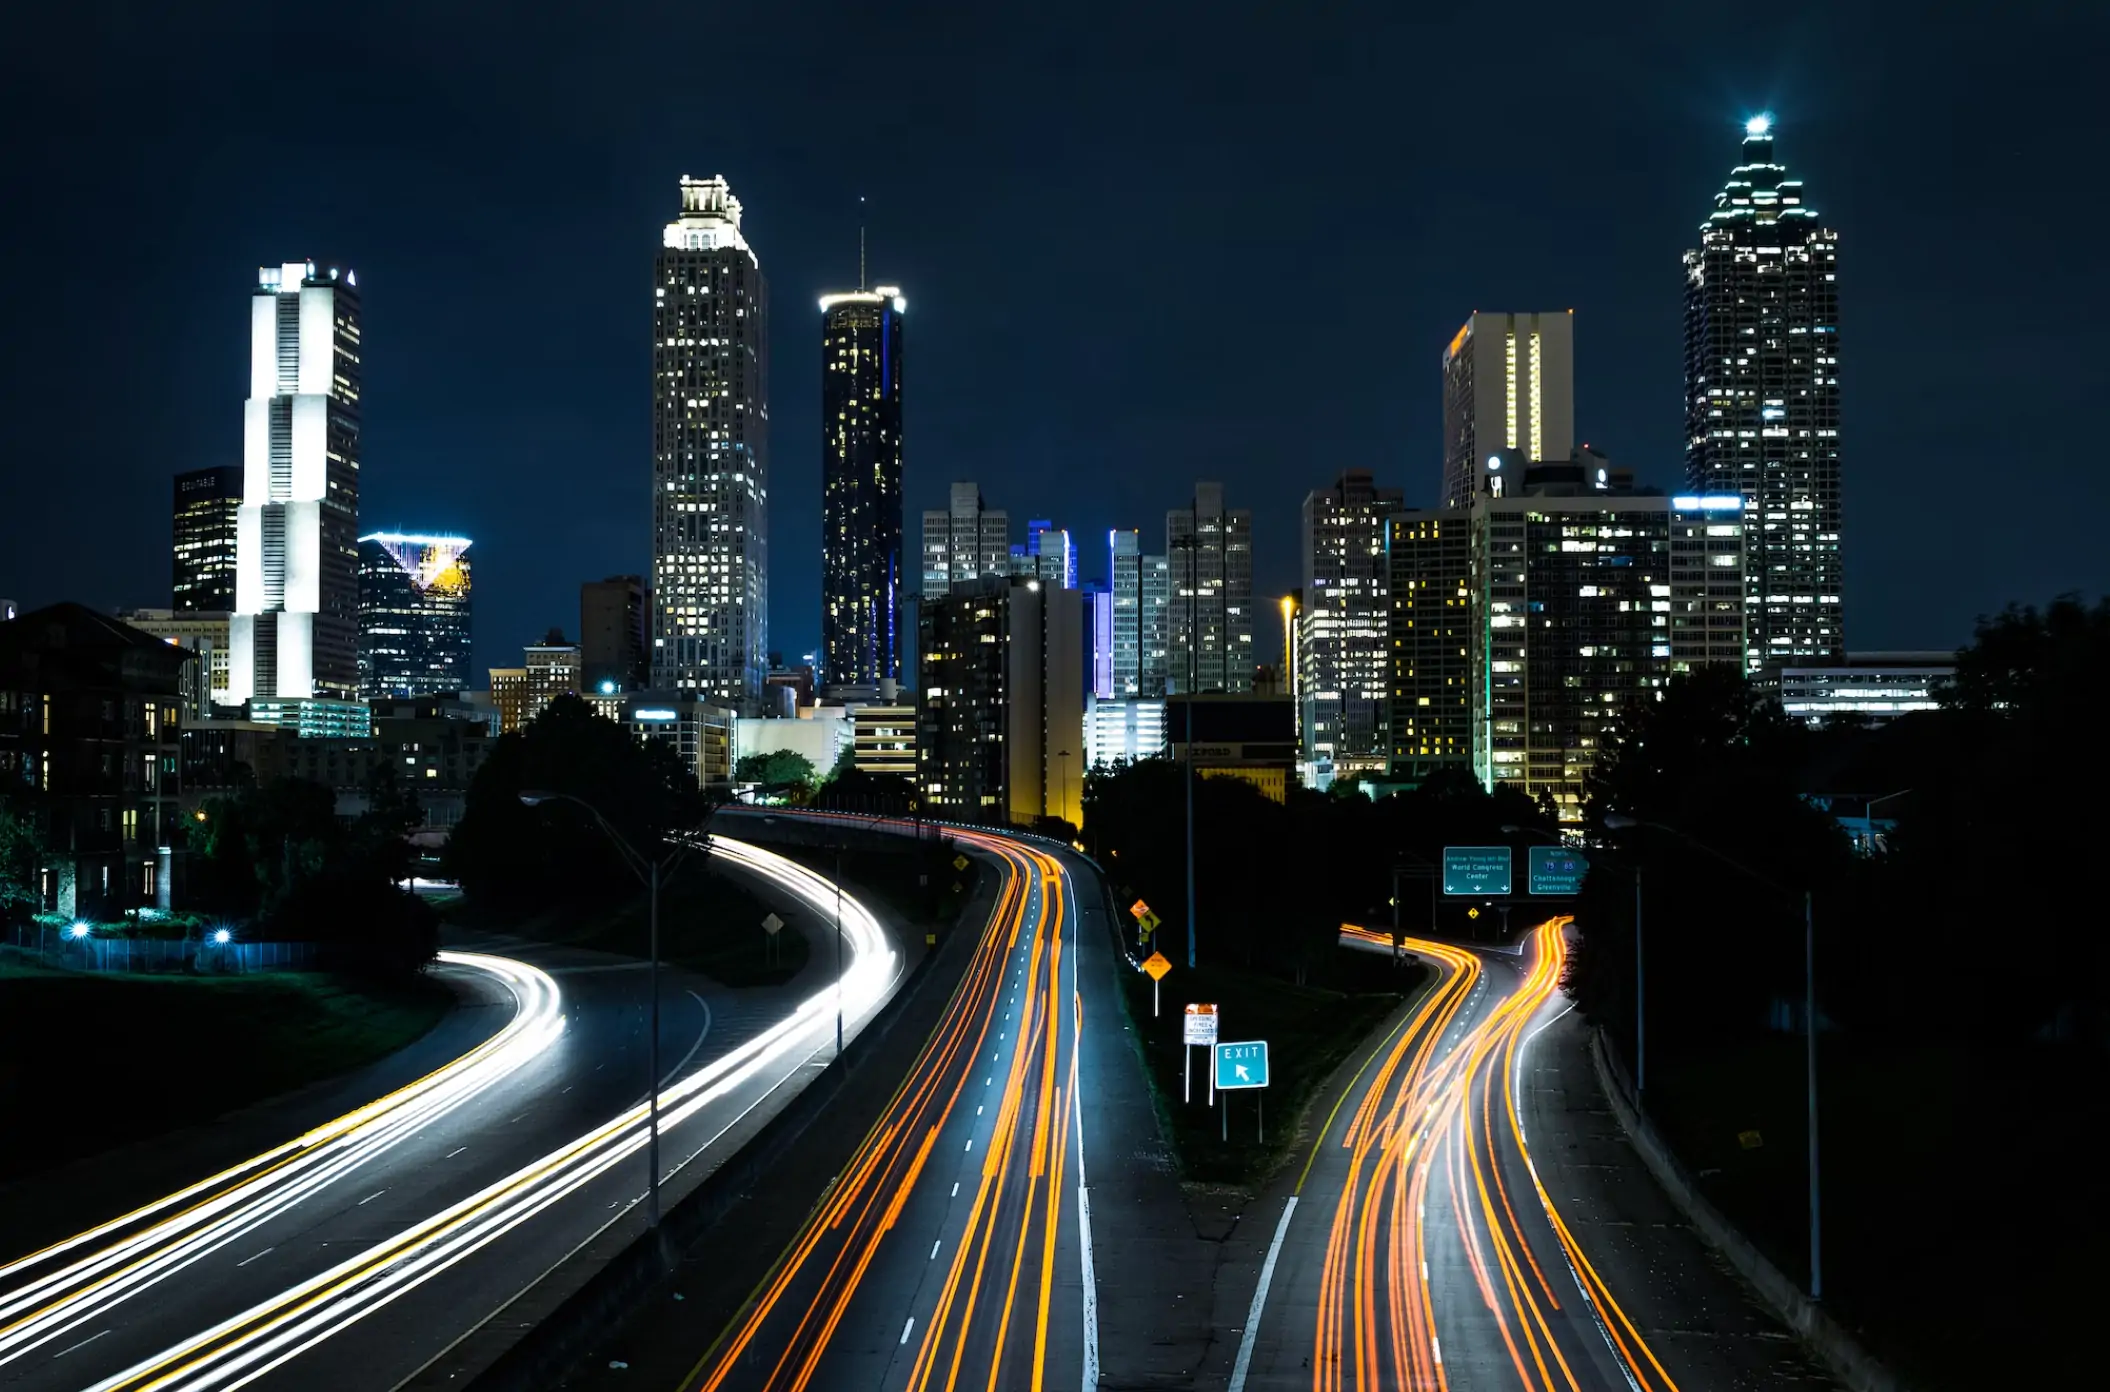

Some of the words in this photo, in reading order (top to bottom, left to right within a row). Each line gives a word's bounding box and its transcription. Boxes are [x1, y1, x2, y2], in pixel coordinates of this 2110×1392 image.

[1472, 864, 1503, 872] Congress
[1466, 872, 1489, 880] Center
[1533, 874, 1576, 883] Chattanooga
[1537, 883, 1571, 891] Greenville
[1224, 1046, 1258, 1059] EXIT
